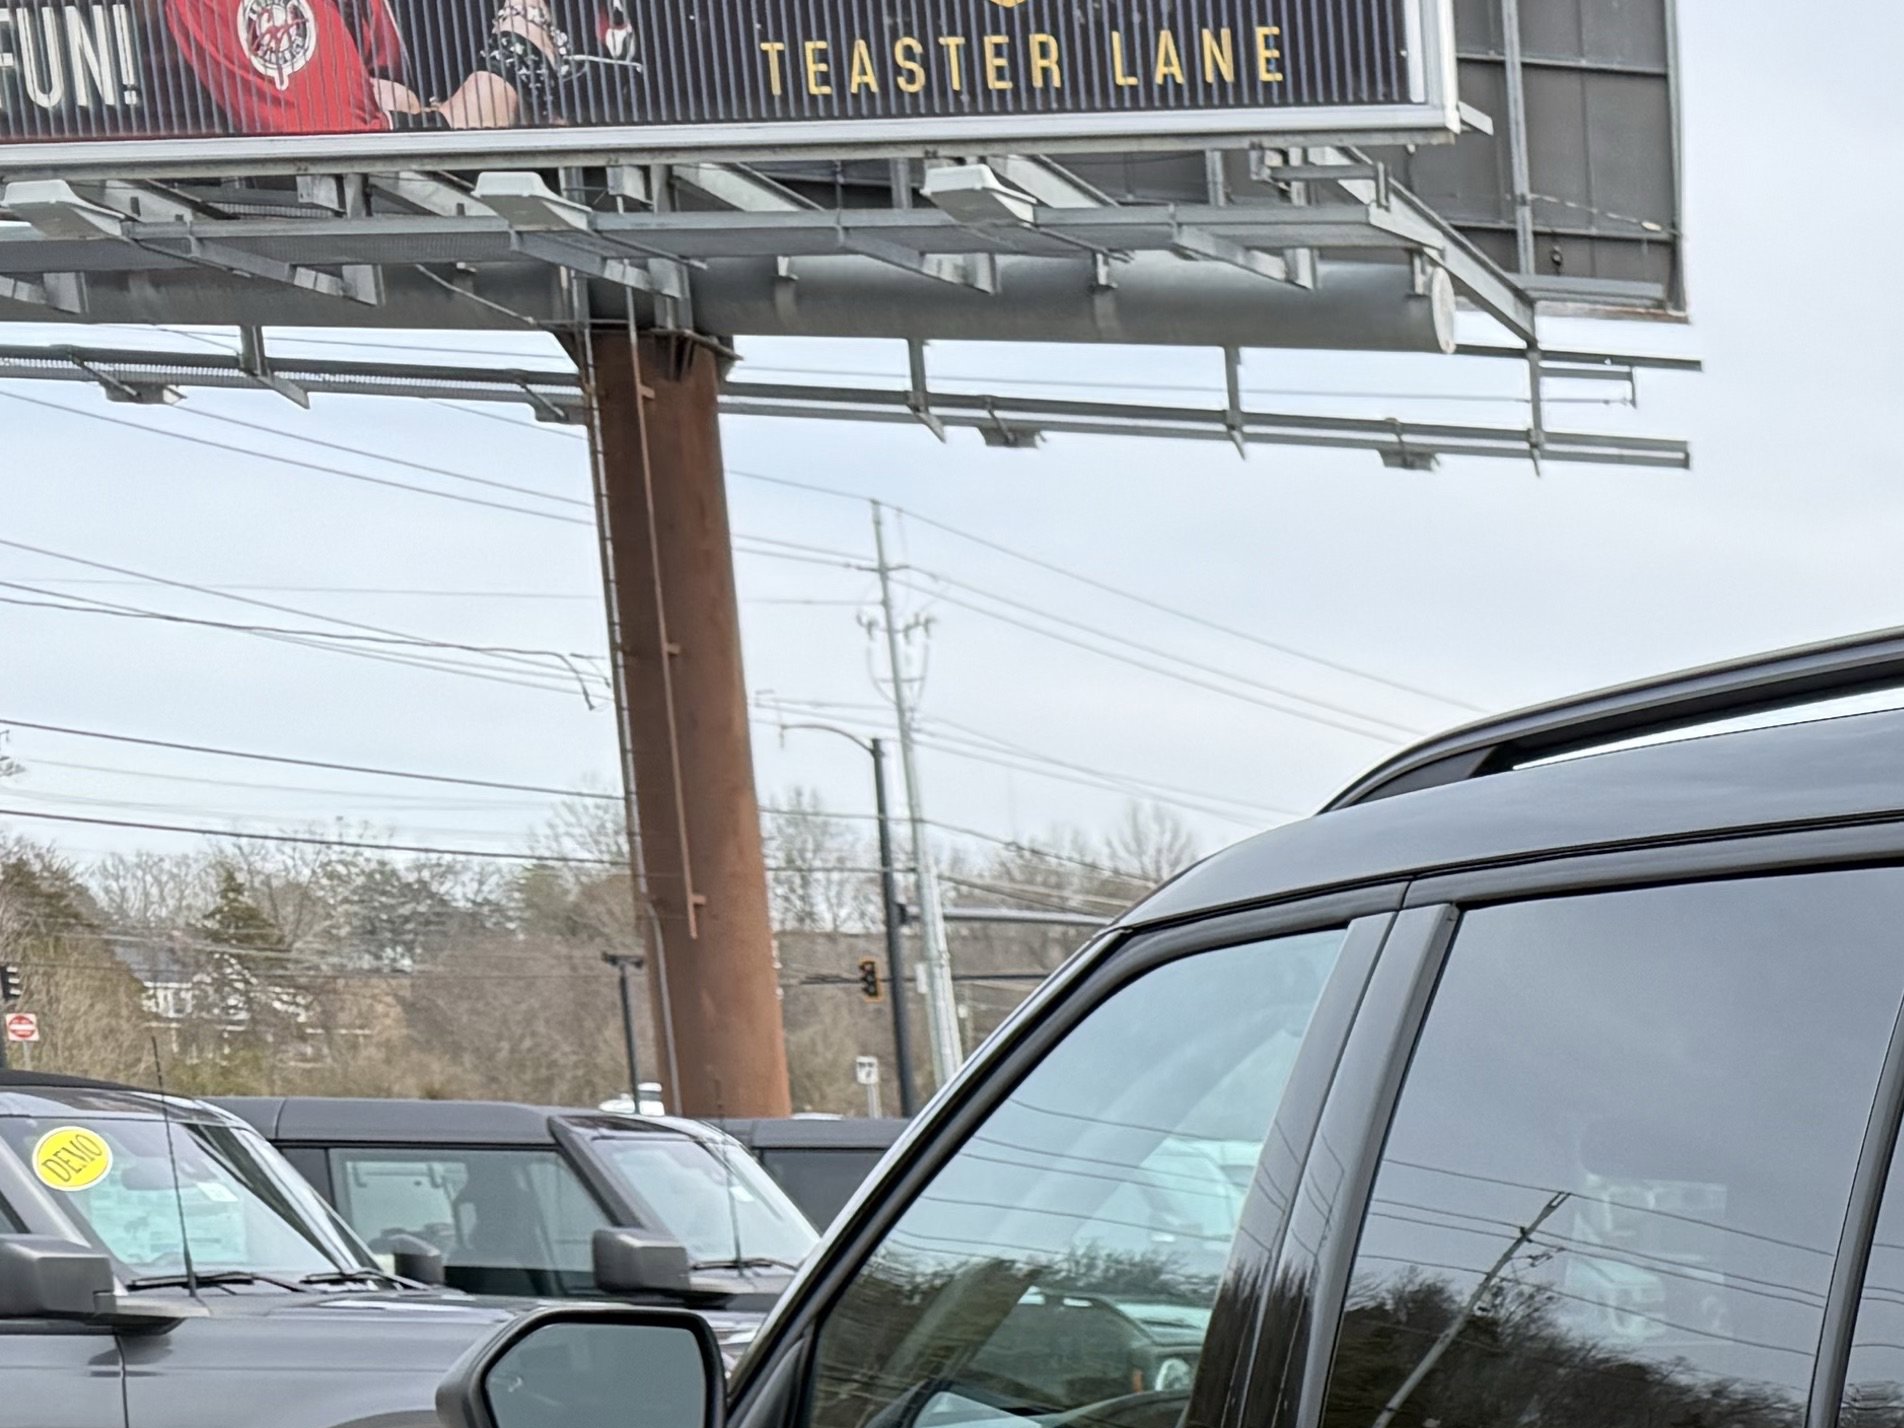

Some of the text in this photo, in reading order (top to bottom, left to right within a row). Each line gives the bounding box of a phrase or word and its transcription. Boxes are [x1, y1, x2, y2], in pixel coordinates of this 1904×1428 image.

[760, 26, 1283, 96] TEASTER LANE
[41, 1134, 102, 1182] DEMO
